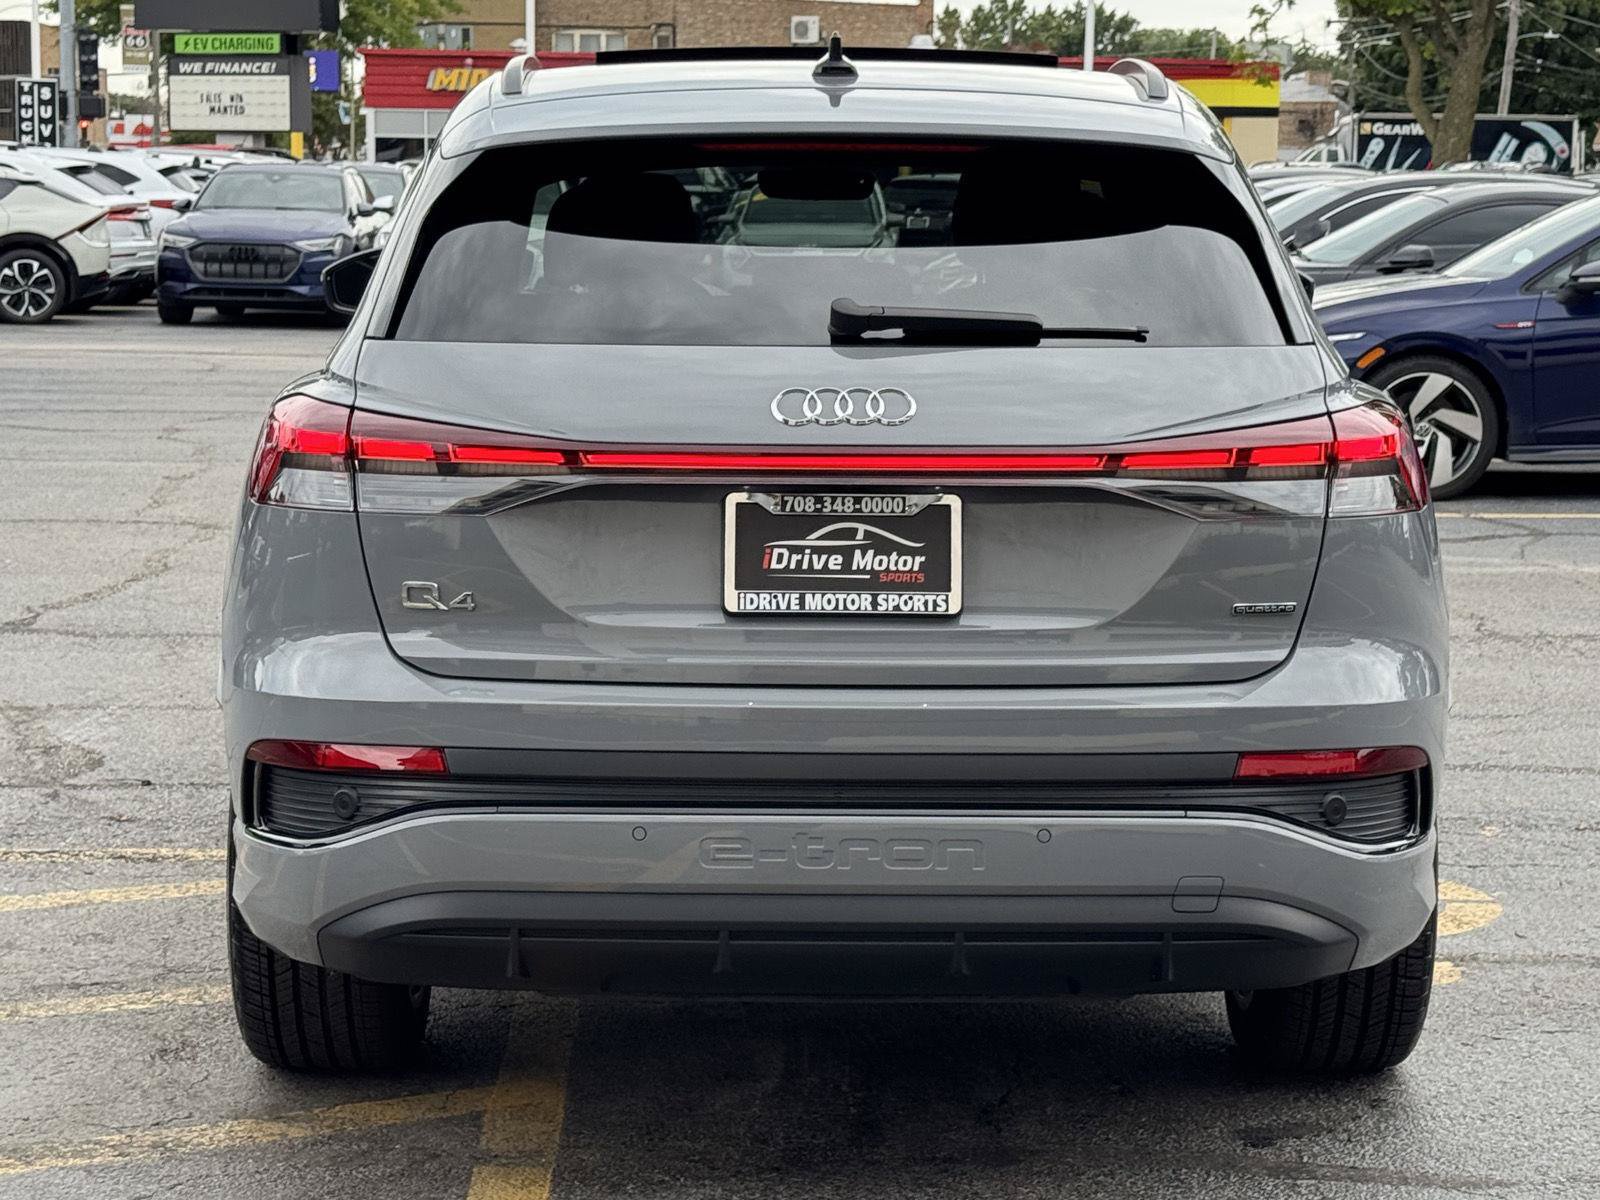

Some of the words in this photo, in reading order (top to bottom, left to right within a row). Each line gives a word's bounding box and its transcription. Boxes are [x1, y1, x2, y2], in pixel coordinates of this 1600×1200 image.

[127, 36, 145, 47] 66
[193, 38, 208, 50] EV
[211, 37, 274, 50] CHARGING
[179, 62, 202, 73] WE
[205, 62, 277, 73] FINANCE!
[784, 496, 903, 513] 708-348-0000
[762, 546, 843, 571] iDrive
[852, 548, 926, 572] Motor
[879, 572, 925, 583] SPORTS
[401, 580, 475, 611] Q4
[805, 593, 873, 611] MOTOR
[877, 594, 948, 612] SPORTS
[1236, 604, 1294, 615] quattro
[700, 832, 985, 870] e-tron
